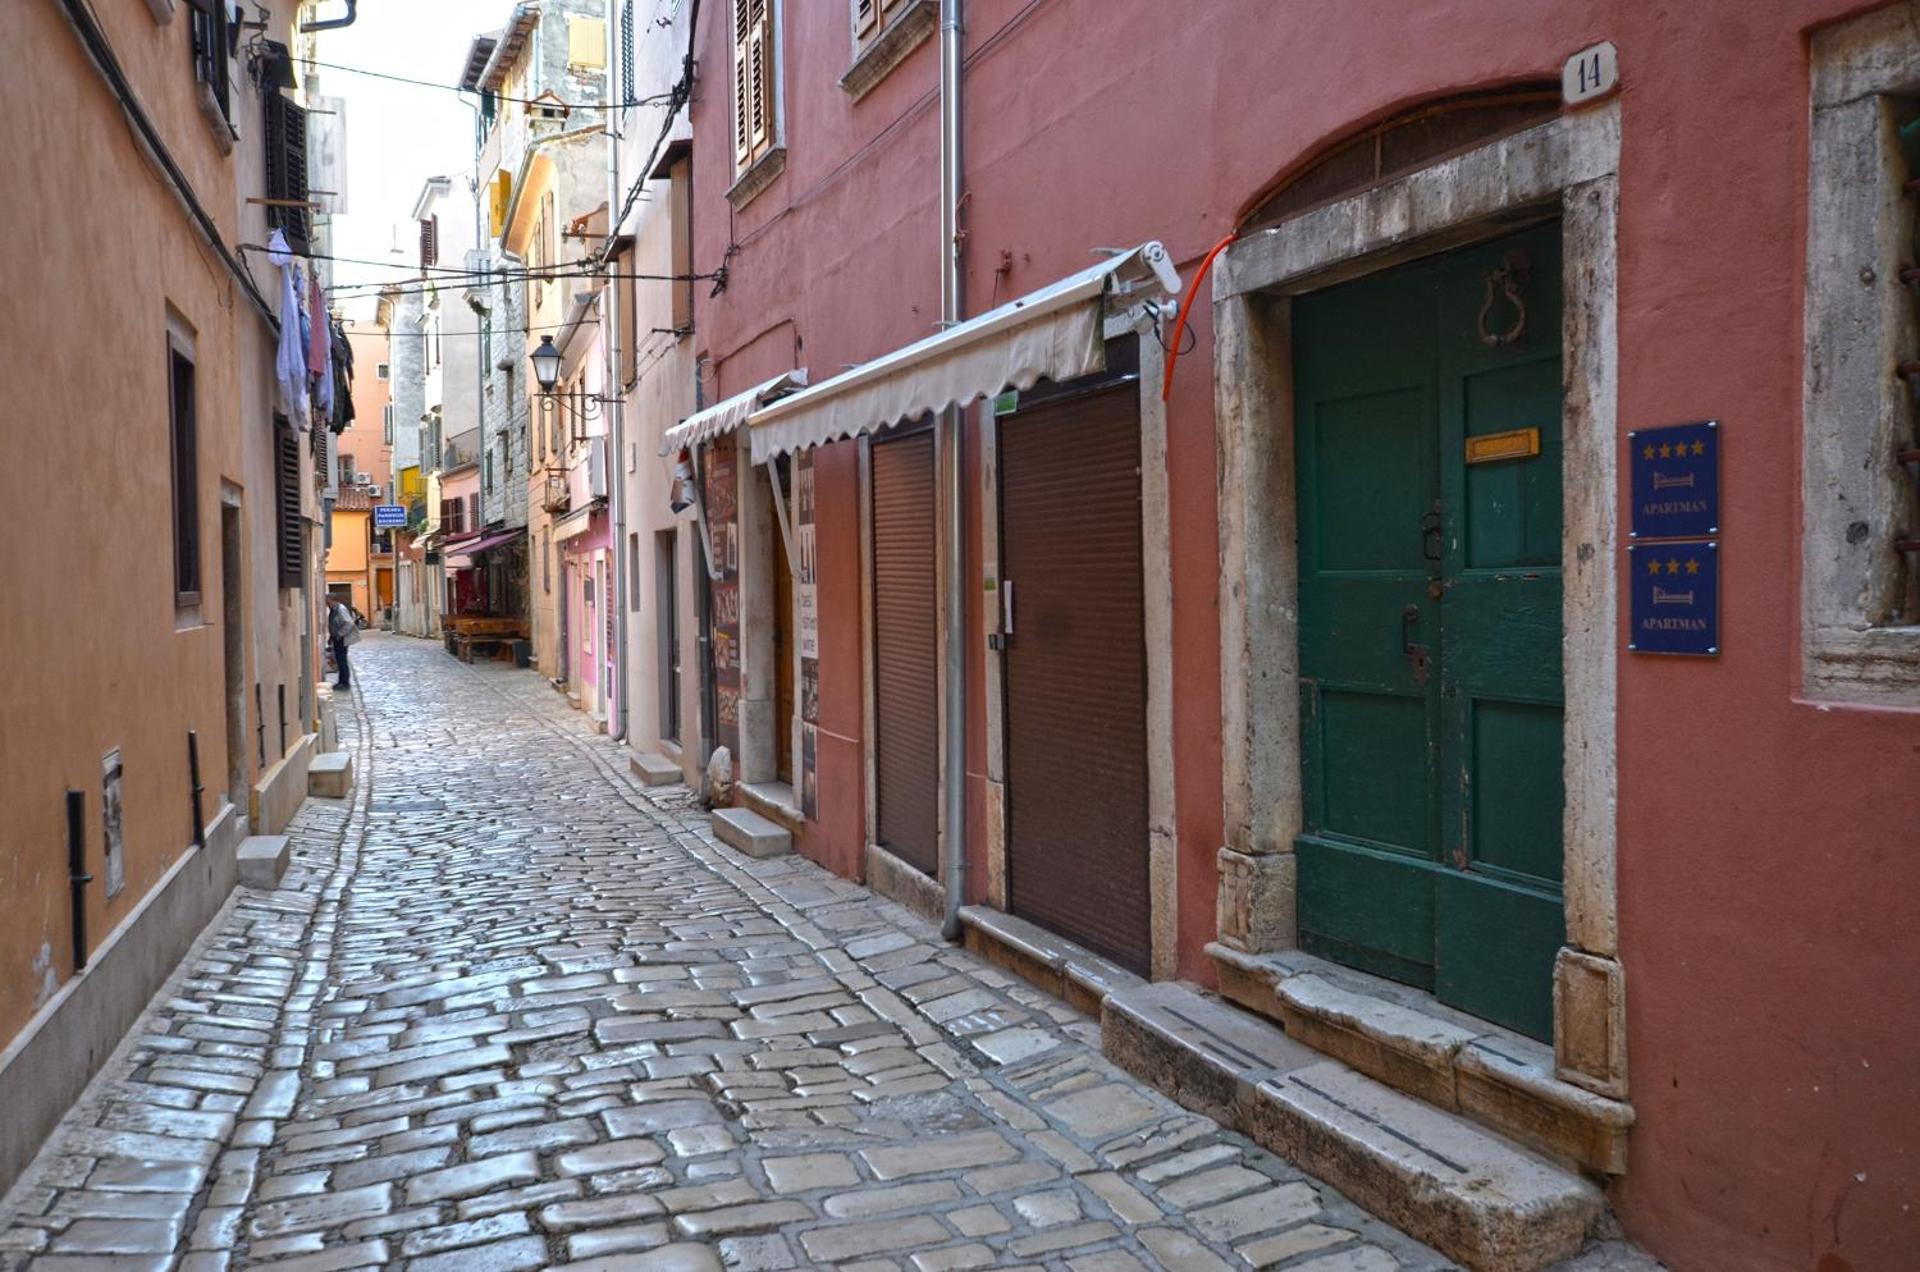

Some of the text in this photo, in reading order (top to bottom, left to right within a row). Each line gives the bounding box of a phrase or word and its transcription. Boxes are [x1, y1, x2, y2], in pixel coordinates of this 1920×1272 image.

[1578, 53, 1600, 93] 14
[1642, 500, 1708, 515] APARTMAN
[1643, 617, 1707, 630] APARTMAN
